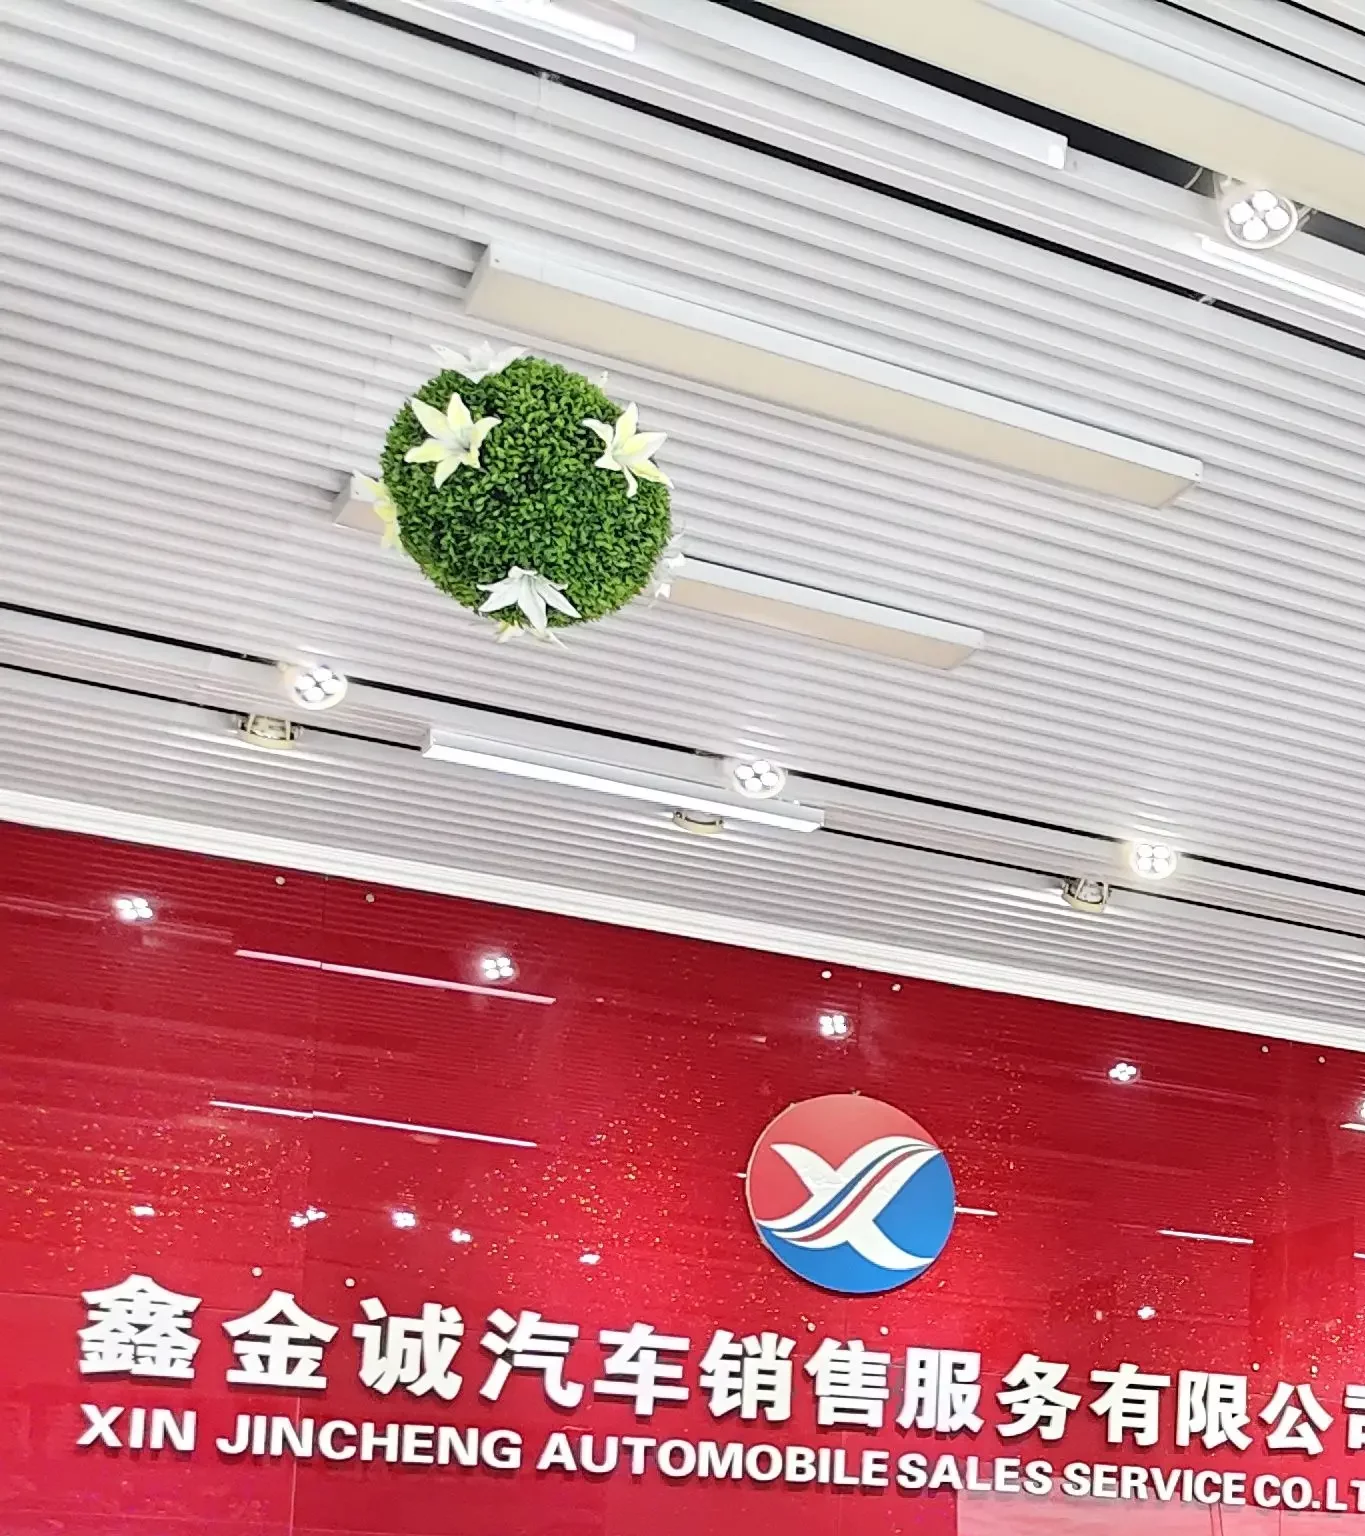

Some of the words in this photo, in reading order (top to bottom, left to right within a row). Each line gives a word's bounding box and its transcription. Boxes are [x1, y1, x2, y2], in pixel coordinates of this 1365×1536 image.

[78, 1404, 197, 1453] XIN
[216, 1412, 522, 1469] JINCHENG
[538, 1432, 886, 1489] AUTOMOBILE
[897, 1450, 1051, 1496] SALES
[1062, 1461, 1246, 1506] SERVICE
